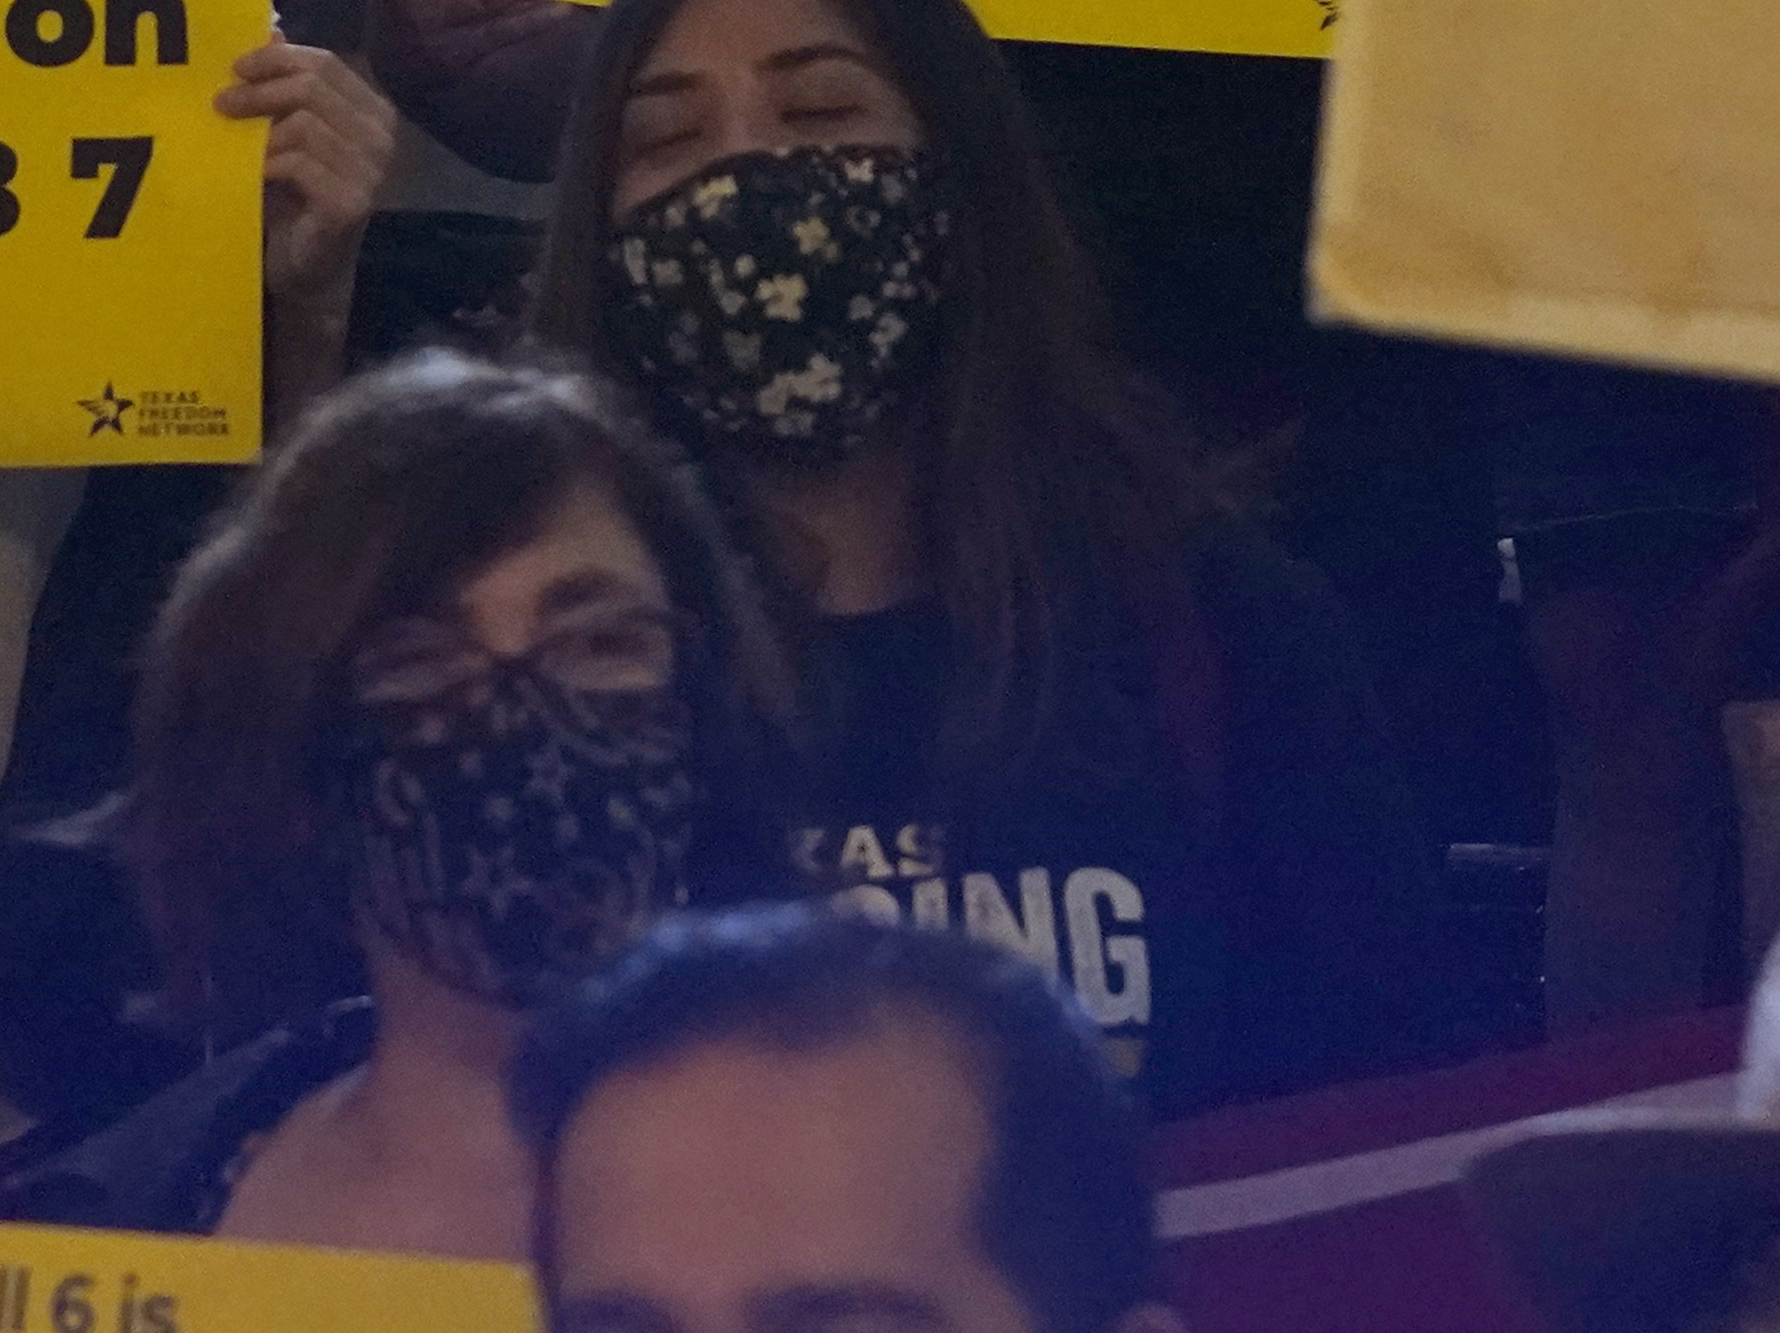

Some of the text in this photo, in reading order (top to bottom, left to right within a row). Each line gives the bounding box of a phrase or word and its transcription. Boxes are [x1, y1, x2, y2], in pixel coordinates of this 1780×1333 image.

[69, 137, 154, 240] 7
[49, 1283, 97, 1333] 6
[120, 1273, 177, 1333] is
